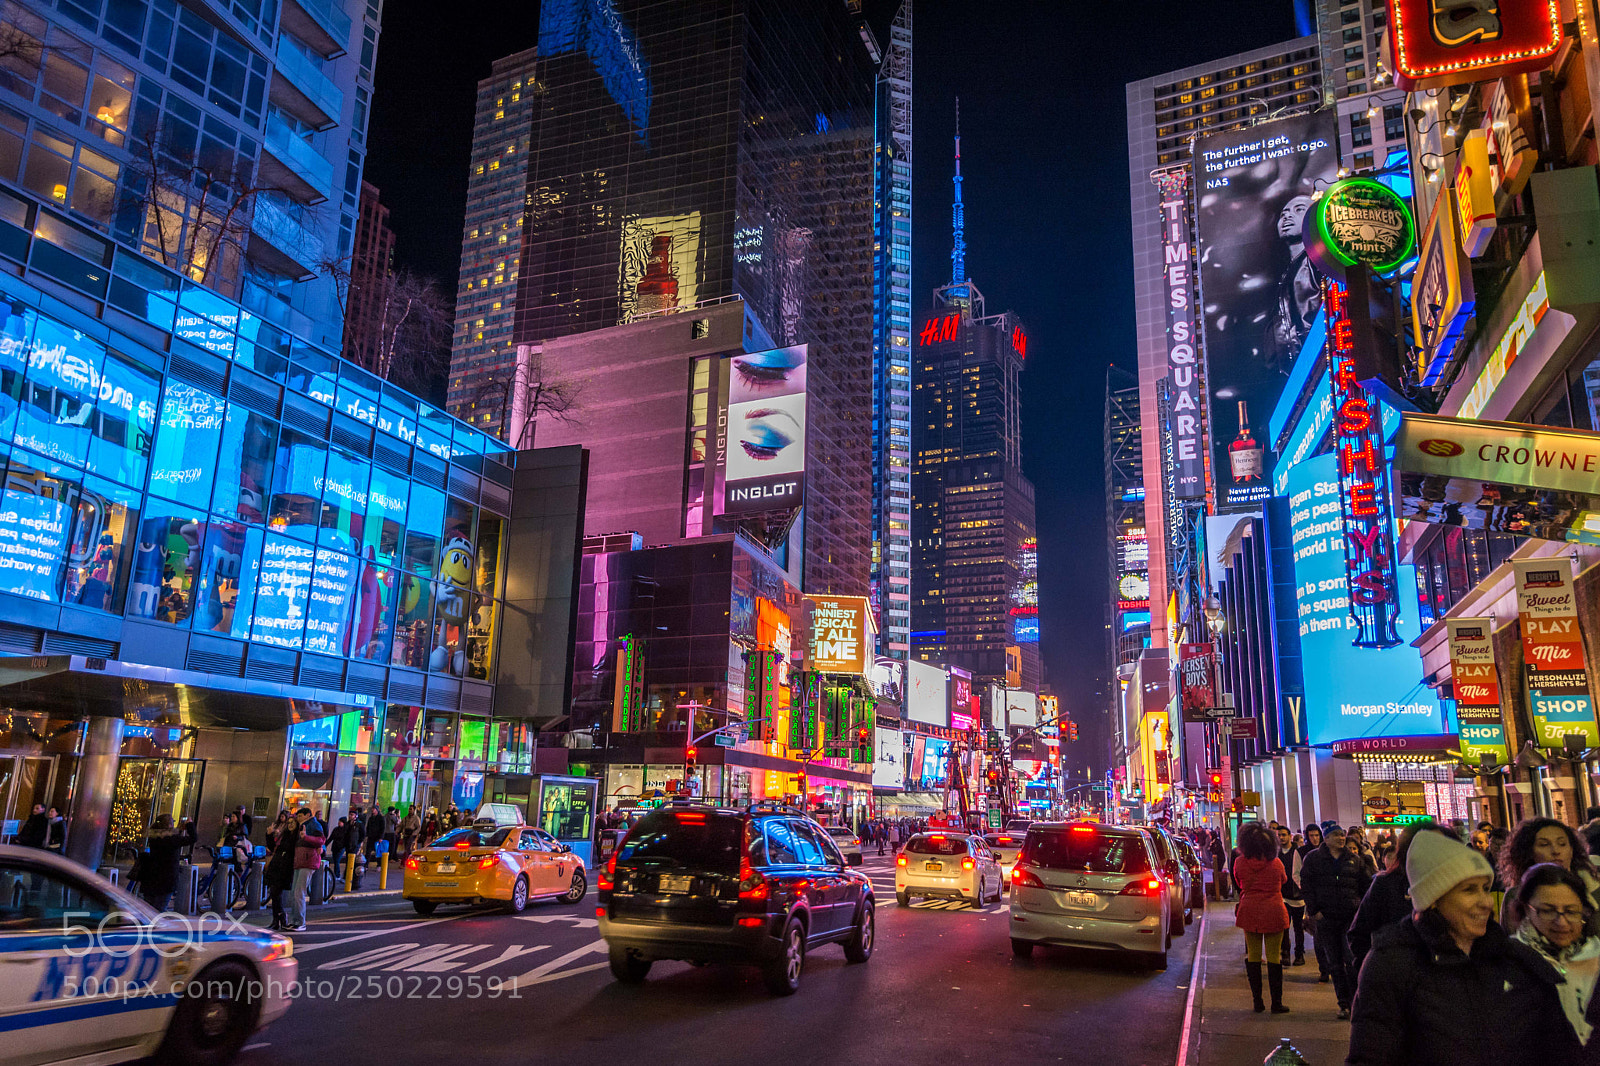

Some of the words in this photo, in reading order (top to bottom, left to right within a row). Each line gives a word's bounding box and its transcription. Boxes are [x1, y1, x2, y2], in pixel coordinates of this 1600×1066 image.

[1203, 150, 1222, 162] The
[1224, 141, 1260, 158] further
[1262, 139, 1266, 149] I
[1268, 134, 1289, 149] get,
[1205, 161, 1223, 173] the
[1224, 153, 1261, 170] further
[1262, 151, 1266, 161] I
[1268, 145, 1294, 160] want
[1296, 142, 1308, 152] to
[1309, 139, 1328, 153] go.
[1206, 177, 1229, 190] NAS
[1163, 200, 1188, 309] TIMES
[1351, 242, 1386, 253] mints
[919, 313, 960, 346] H&M
[1012, 325, 1027, 360] H&M
[1170, 321, 1197, 461] SQUARE
[1314, 411, 1321, 432] in
[716, 406, 727, 466] INGLOT
[1165, 430, 1174, 472] EAGLE
[1478, 444, 1597, 473] CROWNE
[1180, 476, 1198, 484] NYC
[731, 482, 797, 502] INGLOT
[1168, 474, 1178, 546] AMERICAN
[1300, 539, 1327, 559] world
[1331, 537, 1345, 550] in
[1306, 581, 1316, 594] to
[1118, 600, 1150, 609] TOSHIB
[1313, 597, 1350, 614] squar
[1527, 593, 1571, 609] Sweet
[1310, 616, 1341, 632] them
[1526, 619, 1573, 635] PLAY
[826, 629, 857, 641] ALL
[1456, 644, 1490, 656] Sweet
[1532, 645, 1572, 660] Mix
[625, 643, 633, 681] OLIVE
[1182, 656, 1211, 673] JERSEY
[766, 655, 774, 691] OLIVE
[1185, 671, 1208, 687] BOYS
[1456, 666, 1491, 676] PLAY
[1528, 673, 1586, 682] PERSONALIZE
[1460, 685, 1490, 699] Mix
[1535, 680, 1575, 688] HERSHEY'S
[1534, 689, 1541, 697] 4
[621, 684, 630, 731] GARDEN
[1341, 702, 1385, 718] Morgan
[1386, 701, 1433, 718] Stanley
[1537, 700, 1588, 713] SHOP
[1539, 715, 1545, 723] 5
[1462, 728, 1500, 738] SHOP
[1362, 738, 1407, 750] WORLD
[317, 943, 552, 973] ONLY
[31, 947, 163, 1002] NYPD
